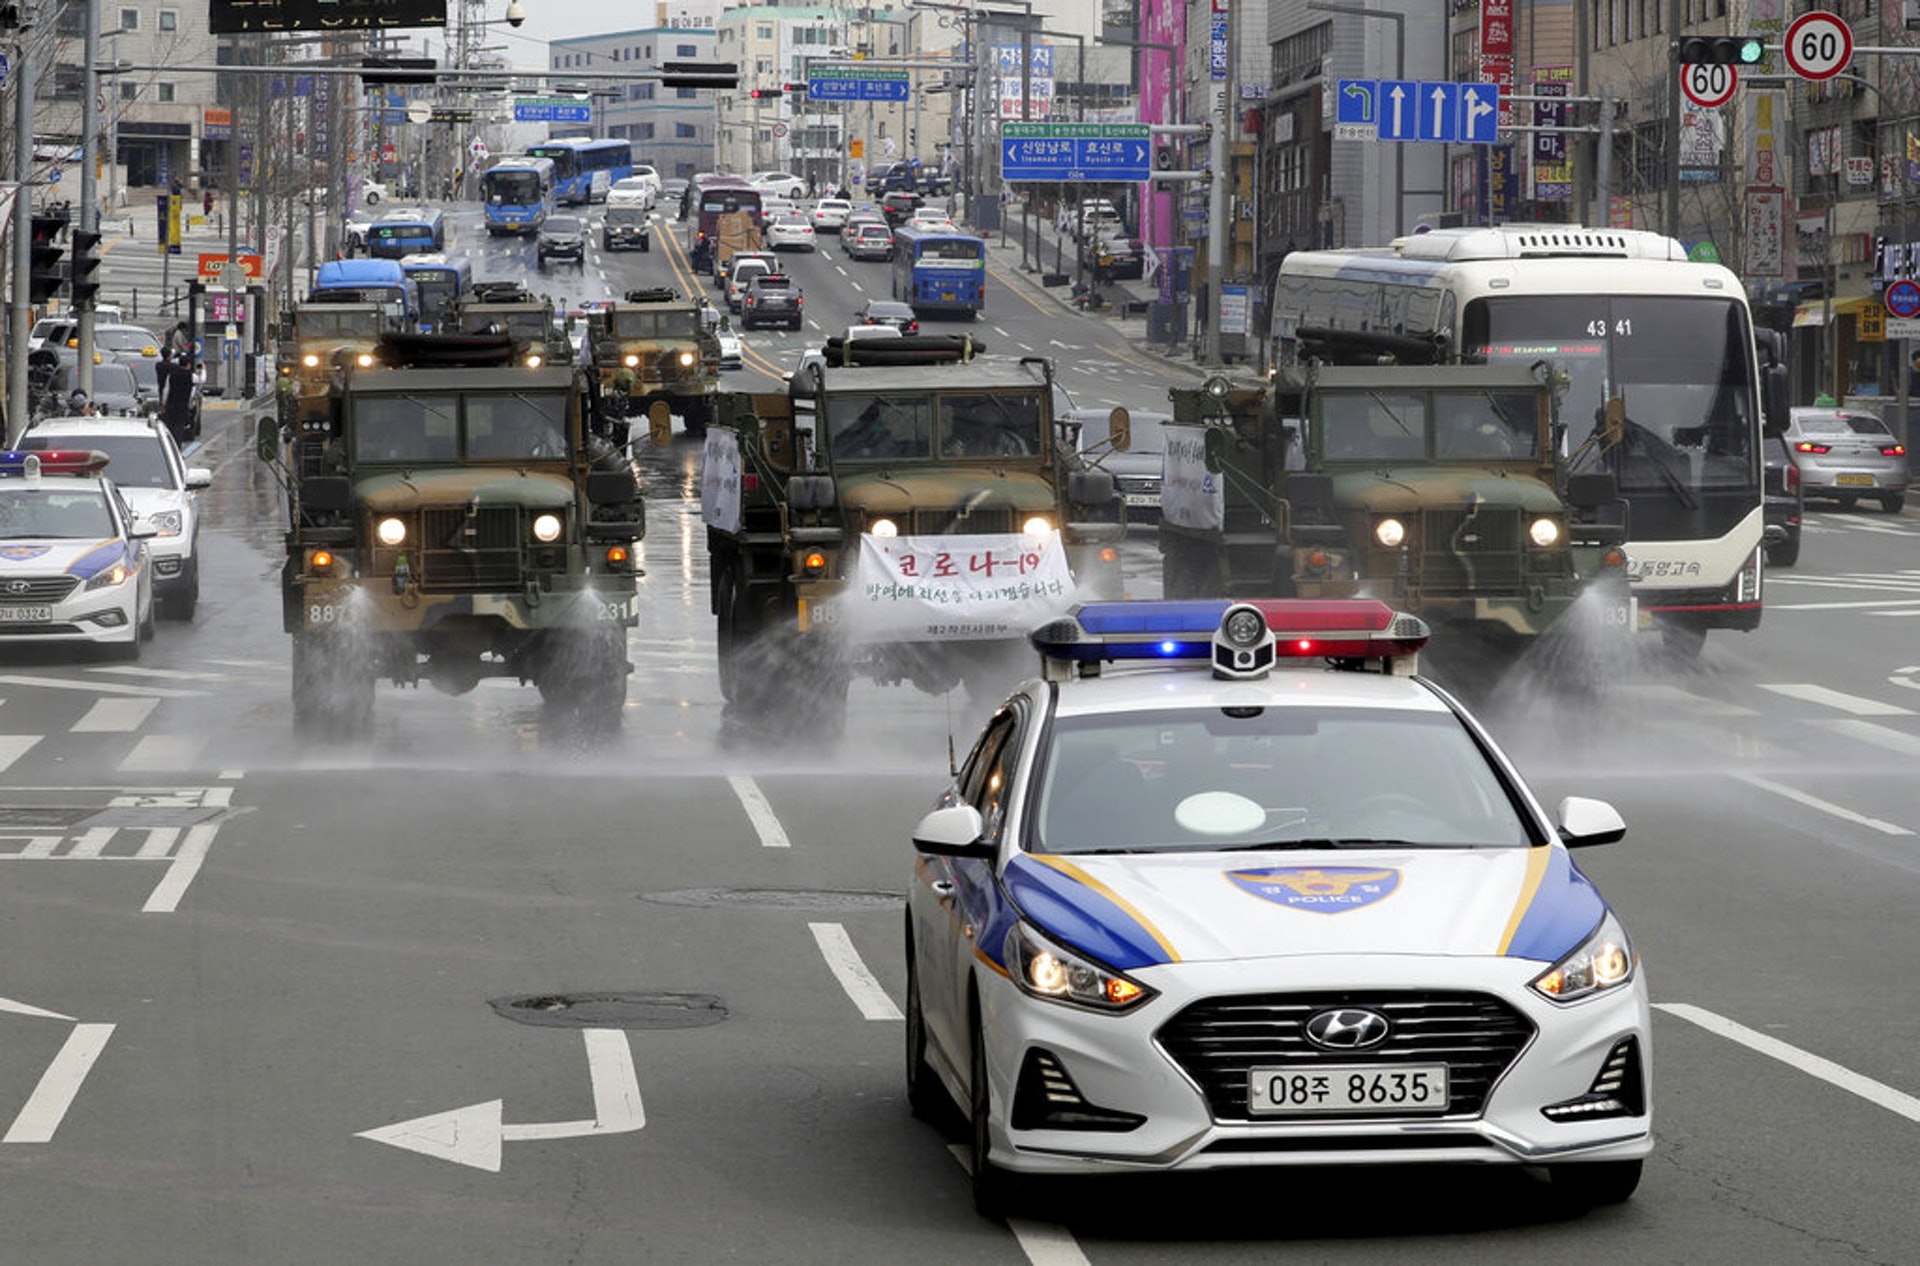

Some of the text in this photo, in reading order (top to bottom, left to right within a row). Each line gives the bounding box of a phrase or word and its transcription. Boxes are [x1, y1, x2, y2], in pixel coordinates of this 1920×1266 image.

[1801, 32, 1837, 61] 60
[1692, 64, 1726, 94] 60
[1021, 142, 1071, 155] 신암남로
[1086, 143, 1124, 155] 효신로
[1587, 319, 1632, 336] 43 41
[1639, 561, 1702, 576] 동양고속
[866, 582, 914, 601] 방역에
[1288, 895, 1363, 904] POLICE
[1268, 1073, 1429, 1105] 08주 8635
